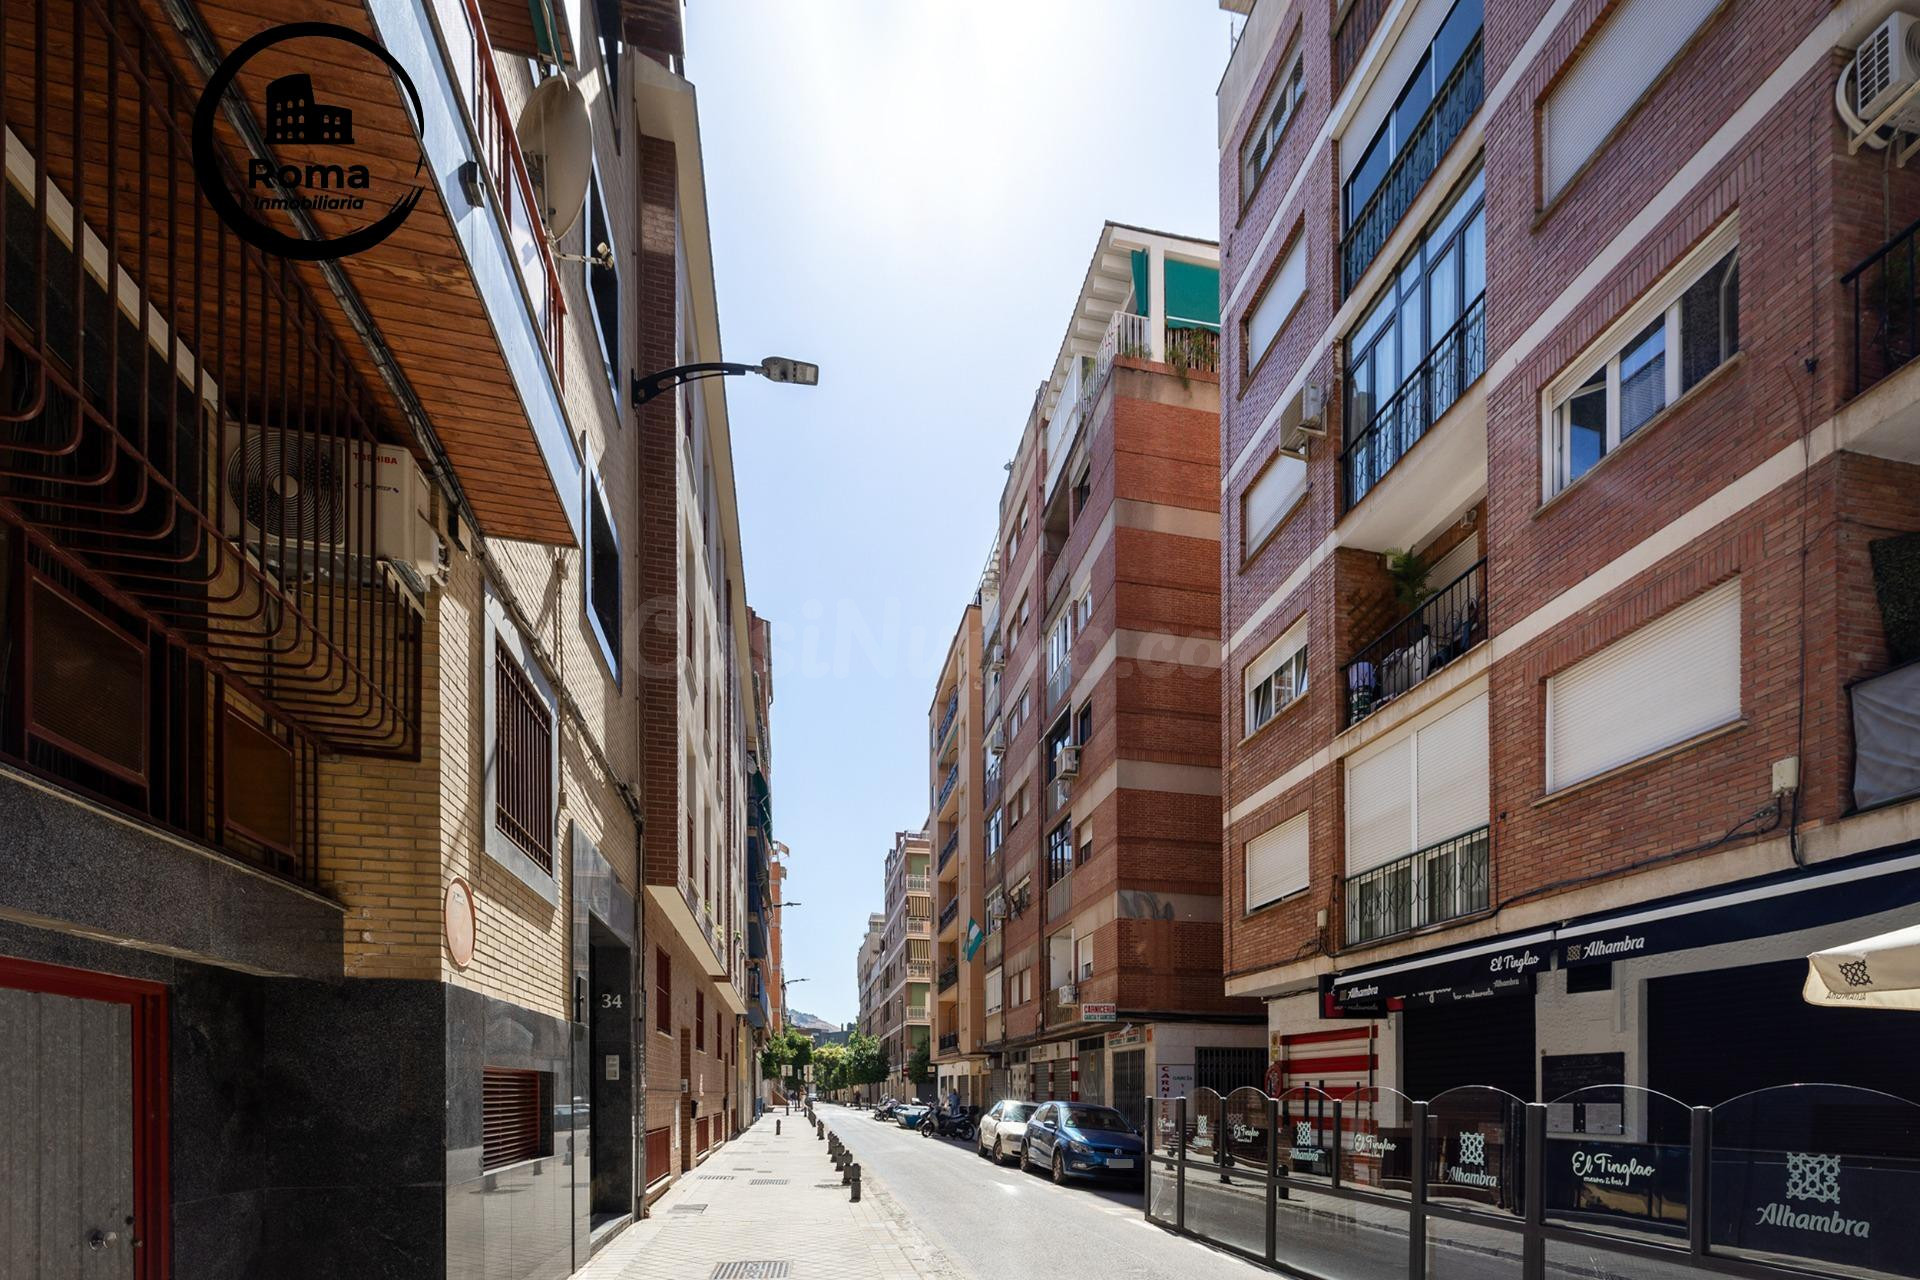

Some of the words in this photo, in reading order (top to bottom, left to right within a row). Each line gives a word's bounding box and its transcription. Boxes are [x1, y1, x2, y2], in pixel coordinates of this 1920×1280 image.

[1582, 935, 1645, 959] Alhambra
[1490, 955, 1502, 972] El
[1503, 950, 1540, 973] Tinglao
[601, 993, 623, 1009] 34
[1347, 984, 1379, 1000] Alhambra
[1445, 1166, 1498, 1188] Alhambra
[1571, 1150, 1593, 1176] El
[1594, 1152, 1656, 1187] Tinglao
[1755, 1202, 1871, 1239] Alhambra
